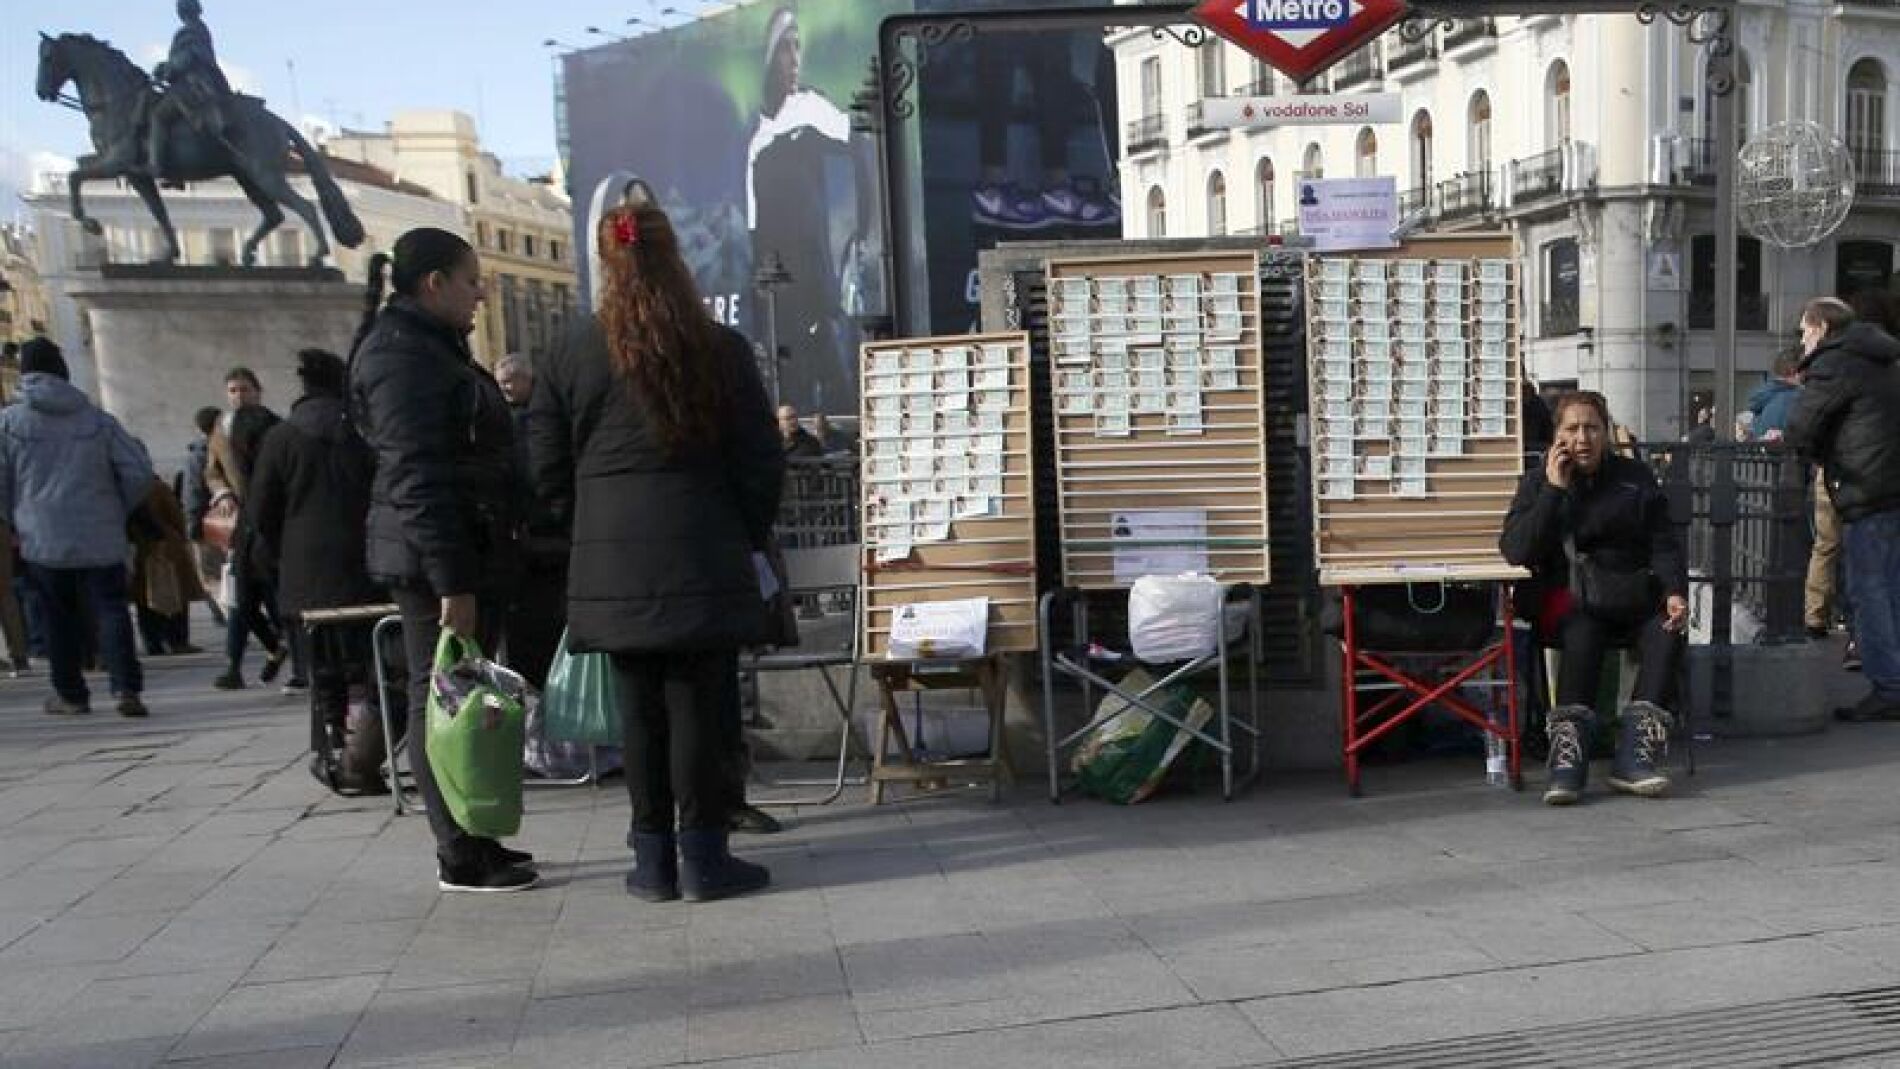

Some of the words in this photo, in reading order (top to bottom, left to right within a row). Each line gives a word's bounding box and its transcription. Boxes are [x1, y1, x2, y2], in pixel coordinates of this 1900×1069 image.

[1256, 0, 1342, 21] Metro
[1263, 101, 1338, 117] vodafone
[1343, 101, 1369, 117] Sol
[702, 294, 740, 325] RE
